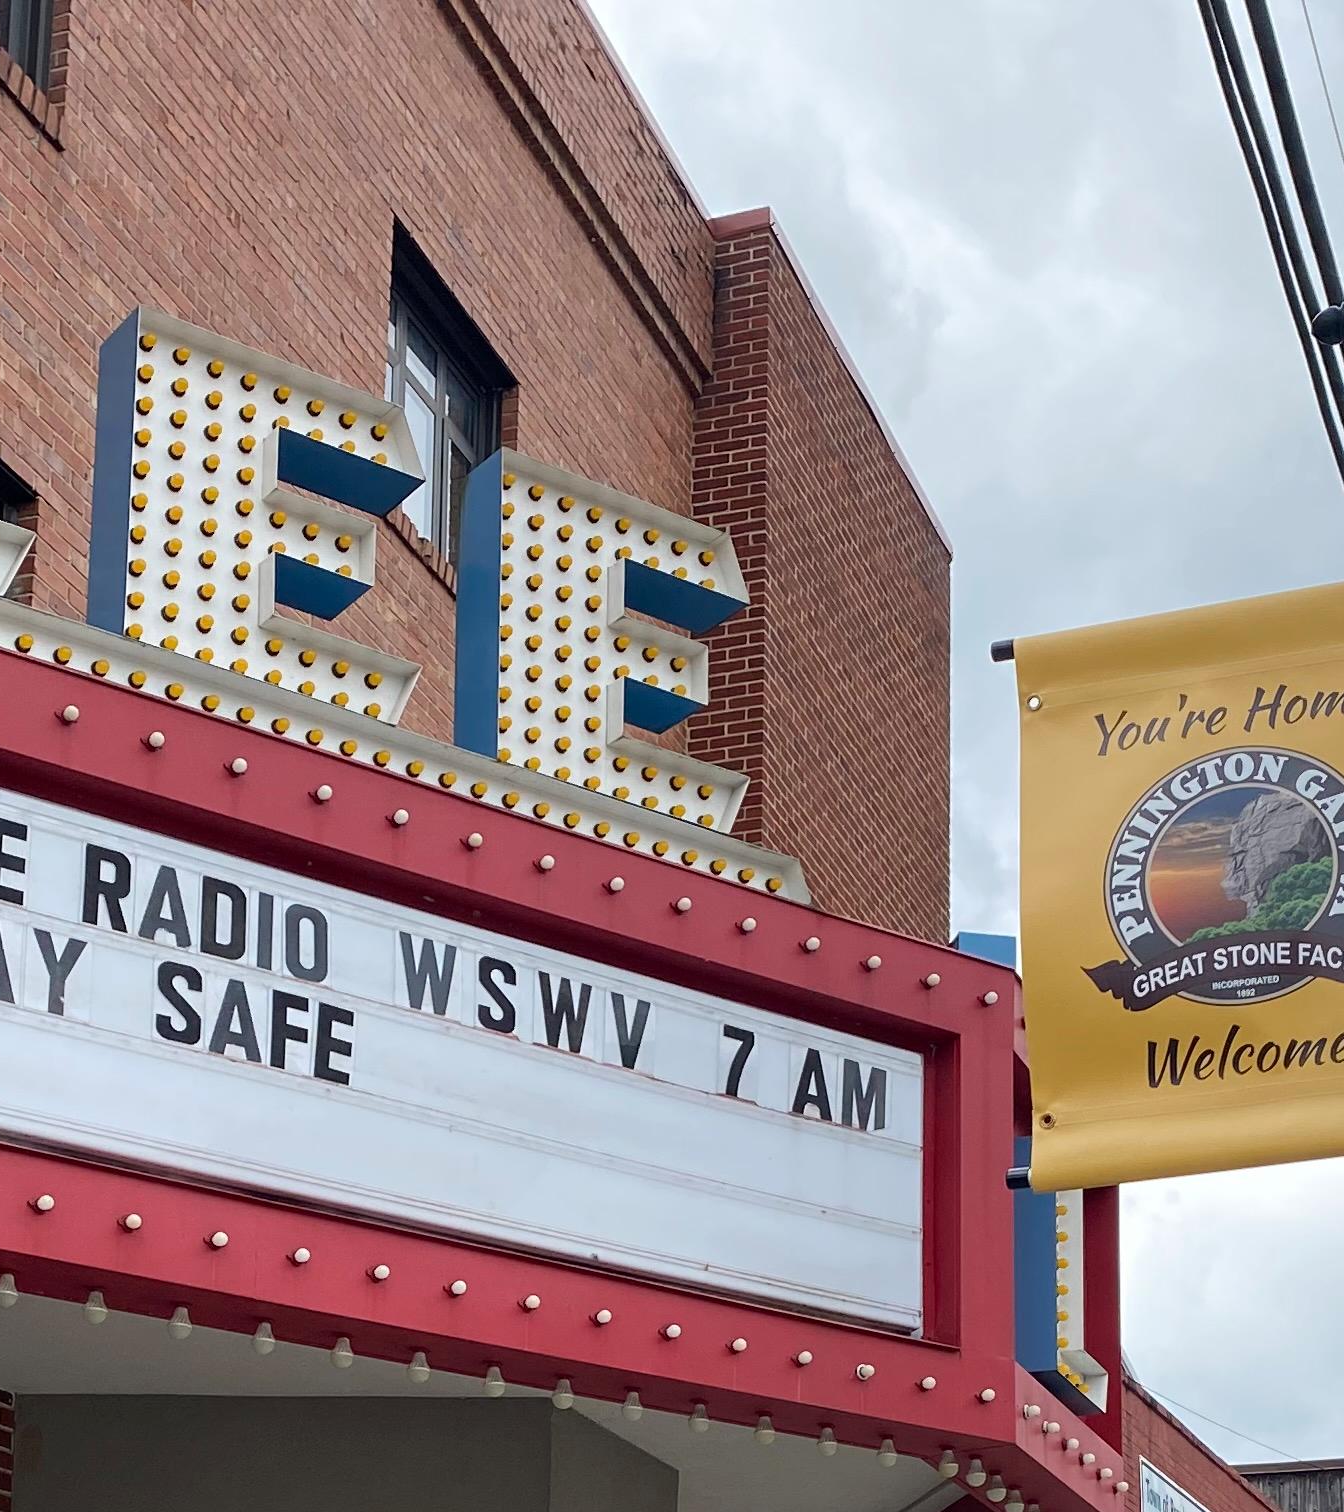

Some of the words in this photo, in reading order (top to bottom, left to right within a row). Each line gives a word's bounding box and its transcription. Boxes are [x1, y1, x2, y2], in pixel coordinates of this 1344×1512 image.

[1093, 693, 1228, 757] You're
[1111, 752, 1290, 946] PENNINGTON
[83, 843, 329, 984] RADIO
[398, 930, 652, 1070] WSWV
[722, 1023, 756, 1098] 7
[793, 1046, 888, 1132] AM
[1132, 951, 1207, 998] GREAT
[1213, 941, 1291, 971] STONE
[1212, 974, 1280, 990] INCORPORATED
[155, 960, 355, 1085] SAFE
